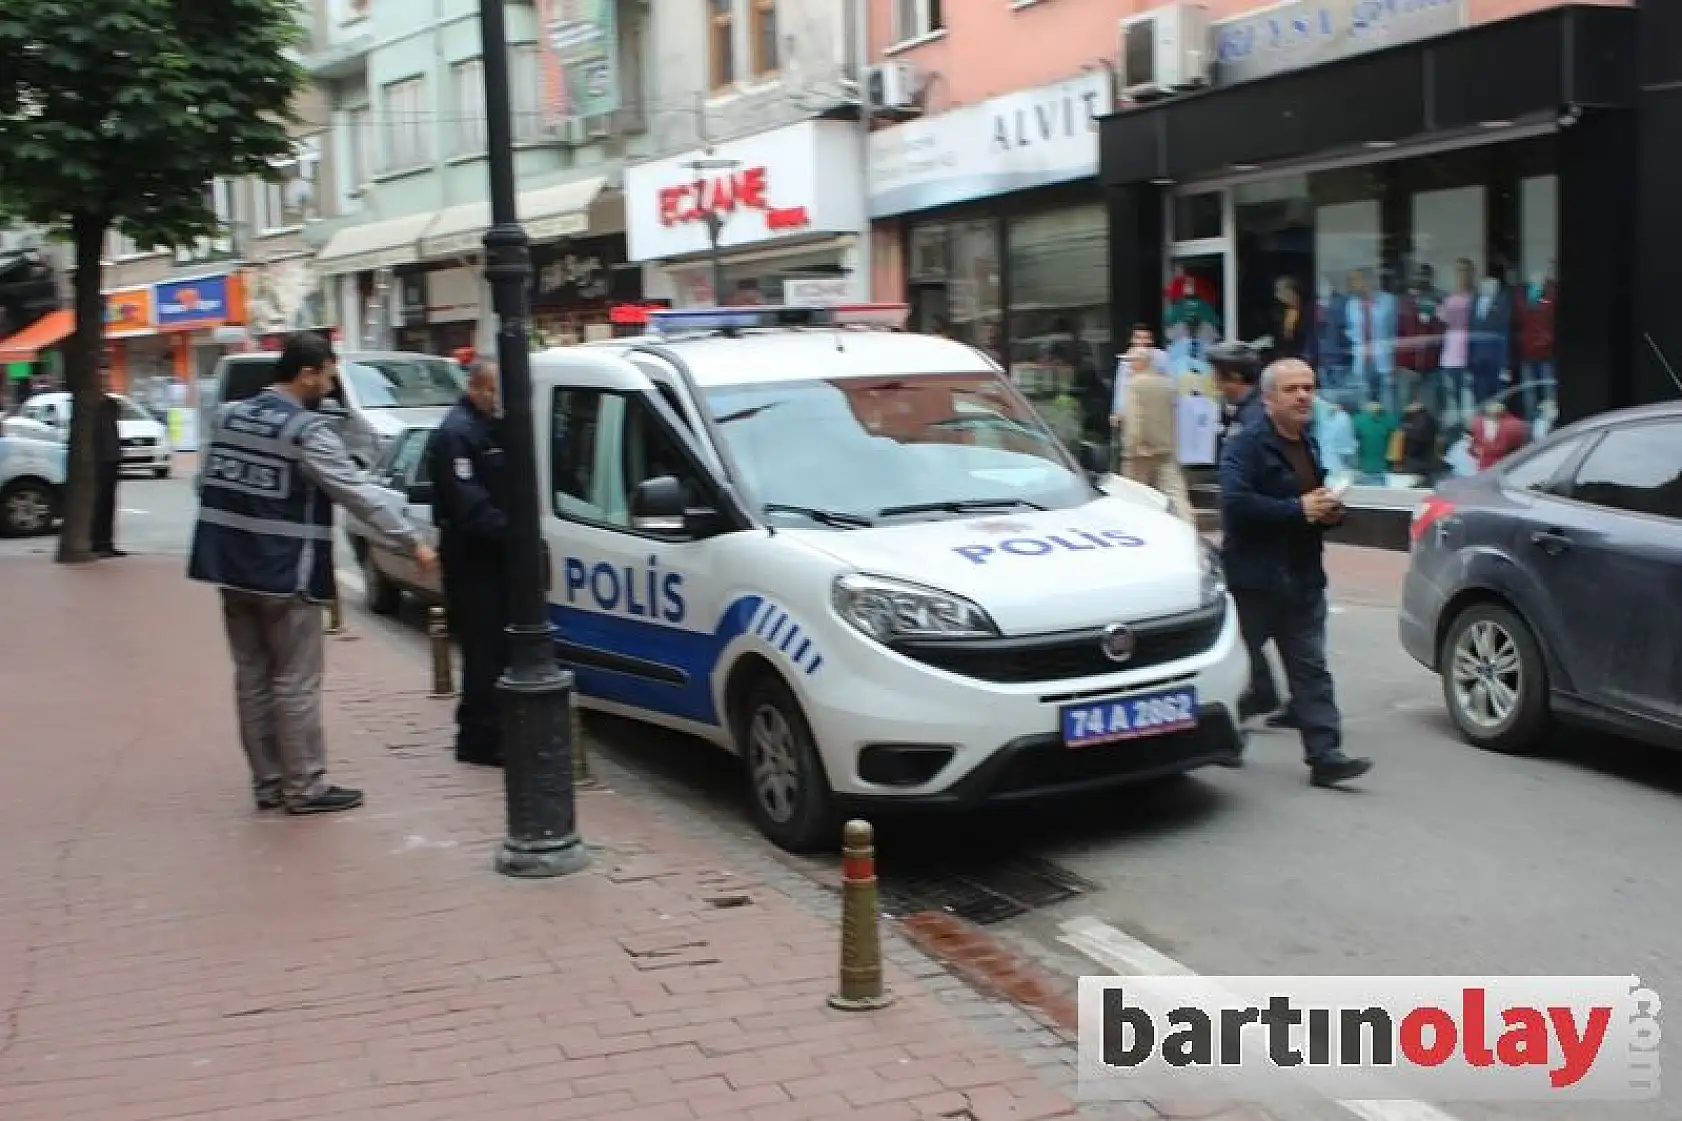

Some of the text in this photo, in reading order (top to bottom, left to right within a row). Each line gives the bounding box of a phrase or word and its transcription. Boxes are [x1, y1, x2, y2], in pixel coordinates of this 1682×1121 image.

[657, 165, 769, 227] ECZANE
[565, 554, 687, 623] POLİS
[1069, 707, 1105, 738] 74
[1109, 703, 1130, 732] A
